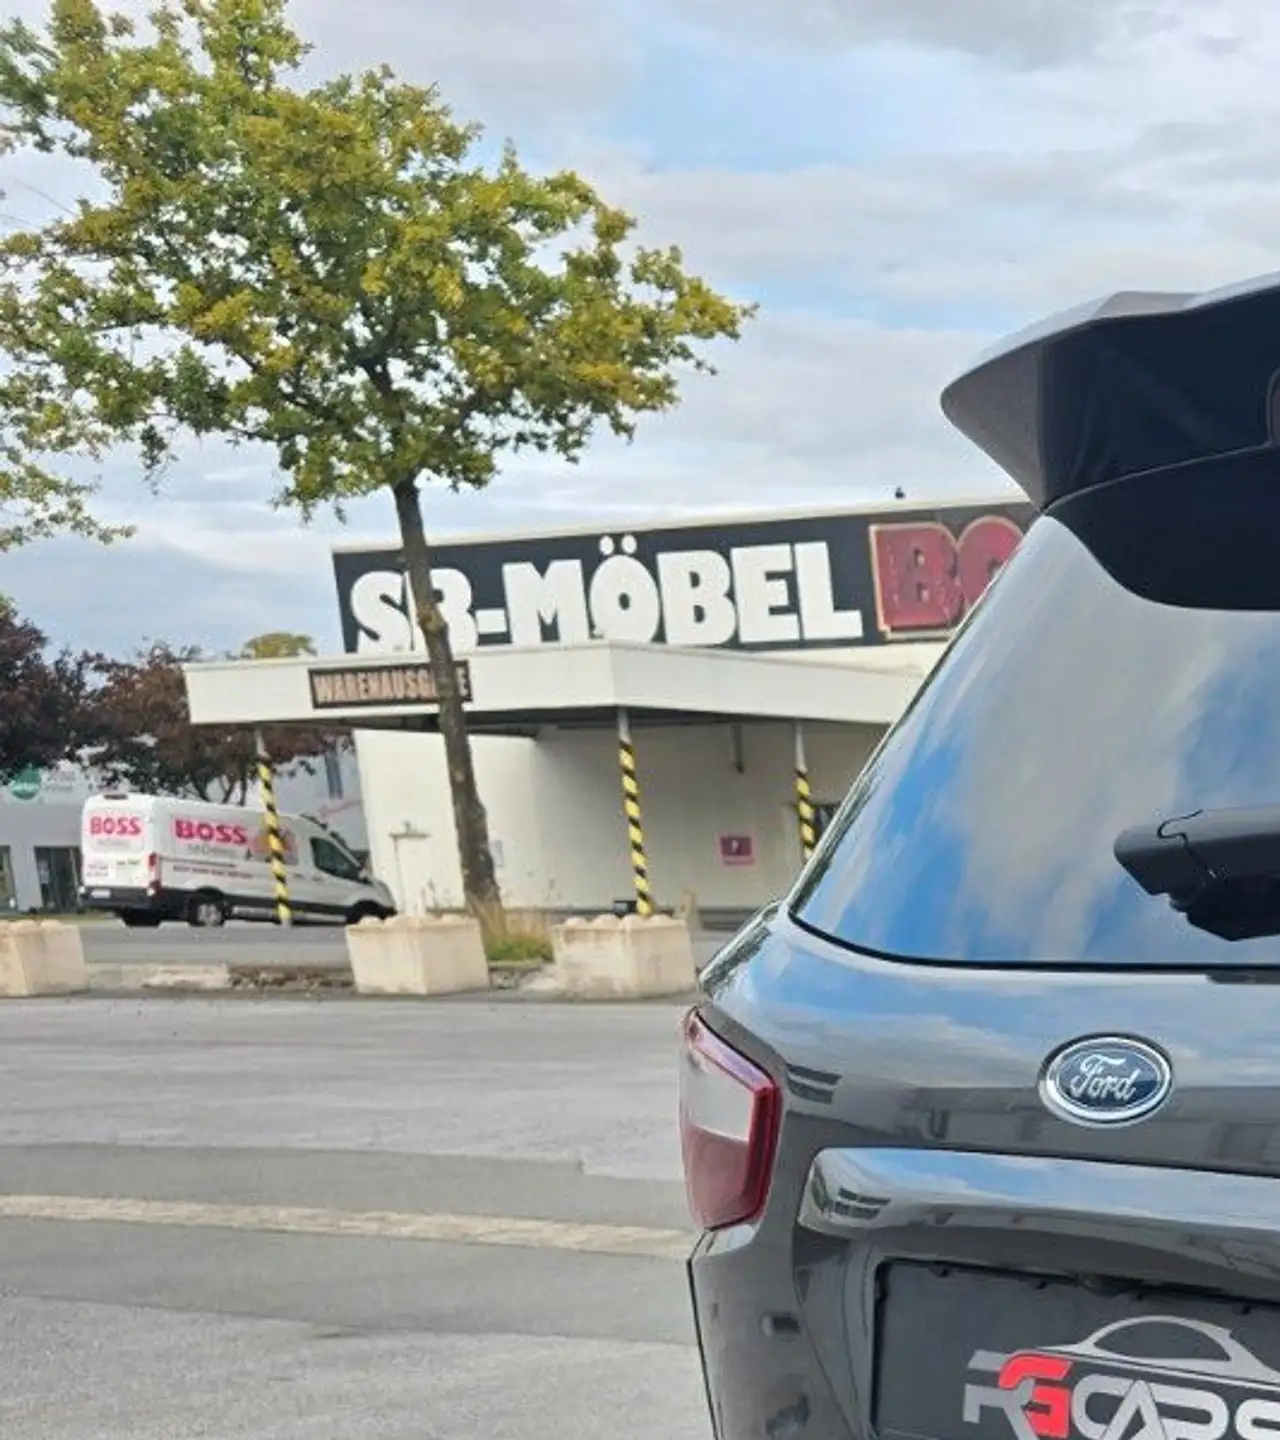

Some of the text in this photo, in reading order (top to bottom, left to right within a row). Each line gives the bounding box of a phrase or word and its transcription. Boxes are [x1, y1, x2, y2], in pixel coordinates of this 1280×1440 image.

[351, 534, 863, 655] SB-MÖBEL
[314, 667, 468, 703] WARENAUSGE
[90, 815, 142, 836] BOSS
[174, 818, 248, 846] BOSS
[1069, 1053, 1142, 1101] Ford
